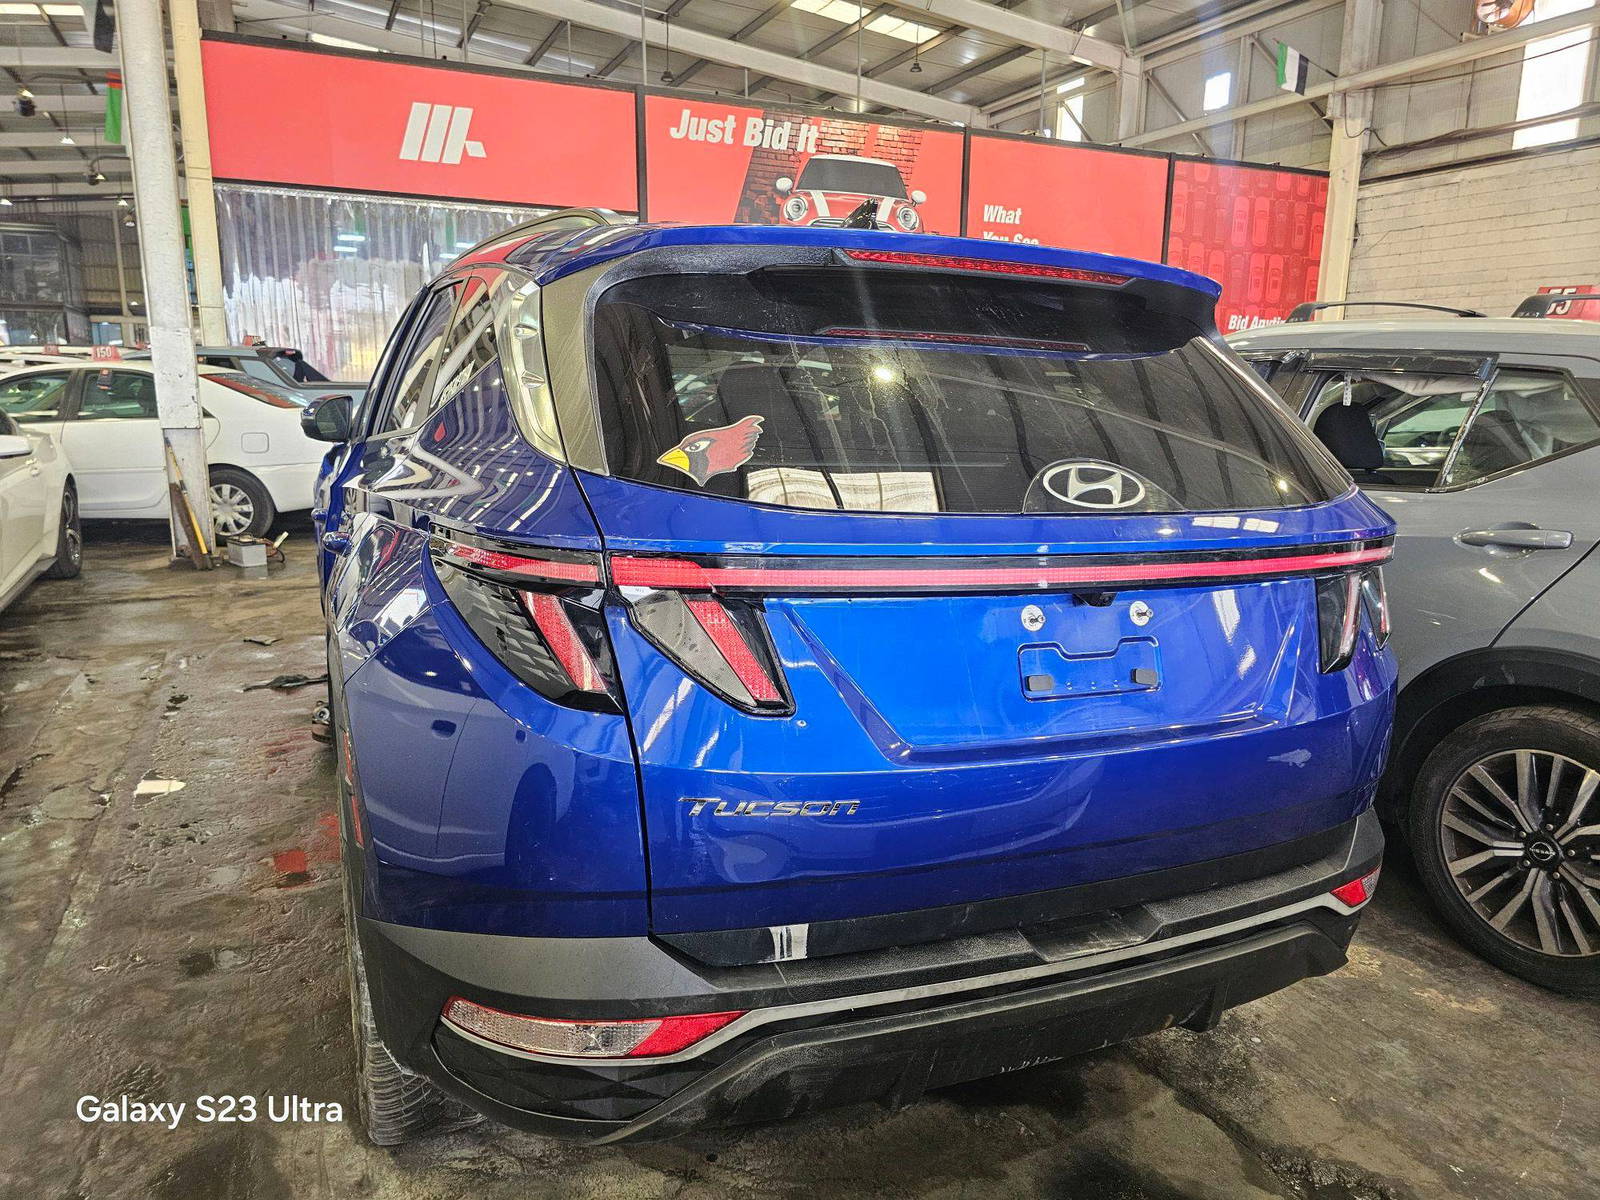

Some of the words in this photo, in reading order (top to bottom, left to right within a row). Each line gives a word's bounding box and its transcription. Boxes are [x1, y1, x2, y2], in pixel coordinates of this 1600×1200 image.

[669, 108, 737, 145] Just
[743, 116, 791, 151] Bid
[797, 123, 819, 154] It
[983, 204, 1022, 225] What
[1228, 314, 1249, 330] Bid
